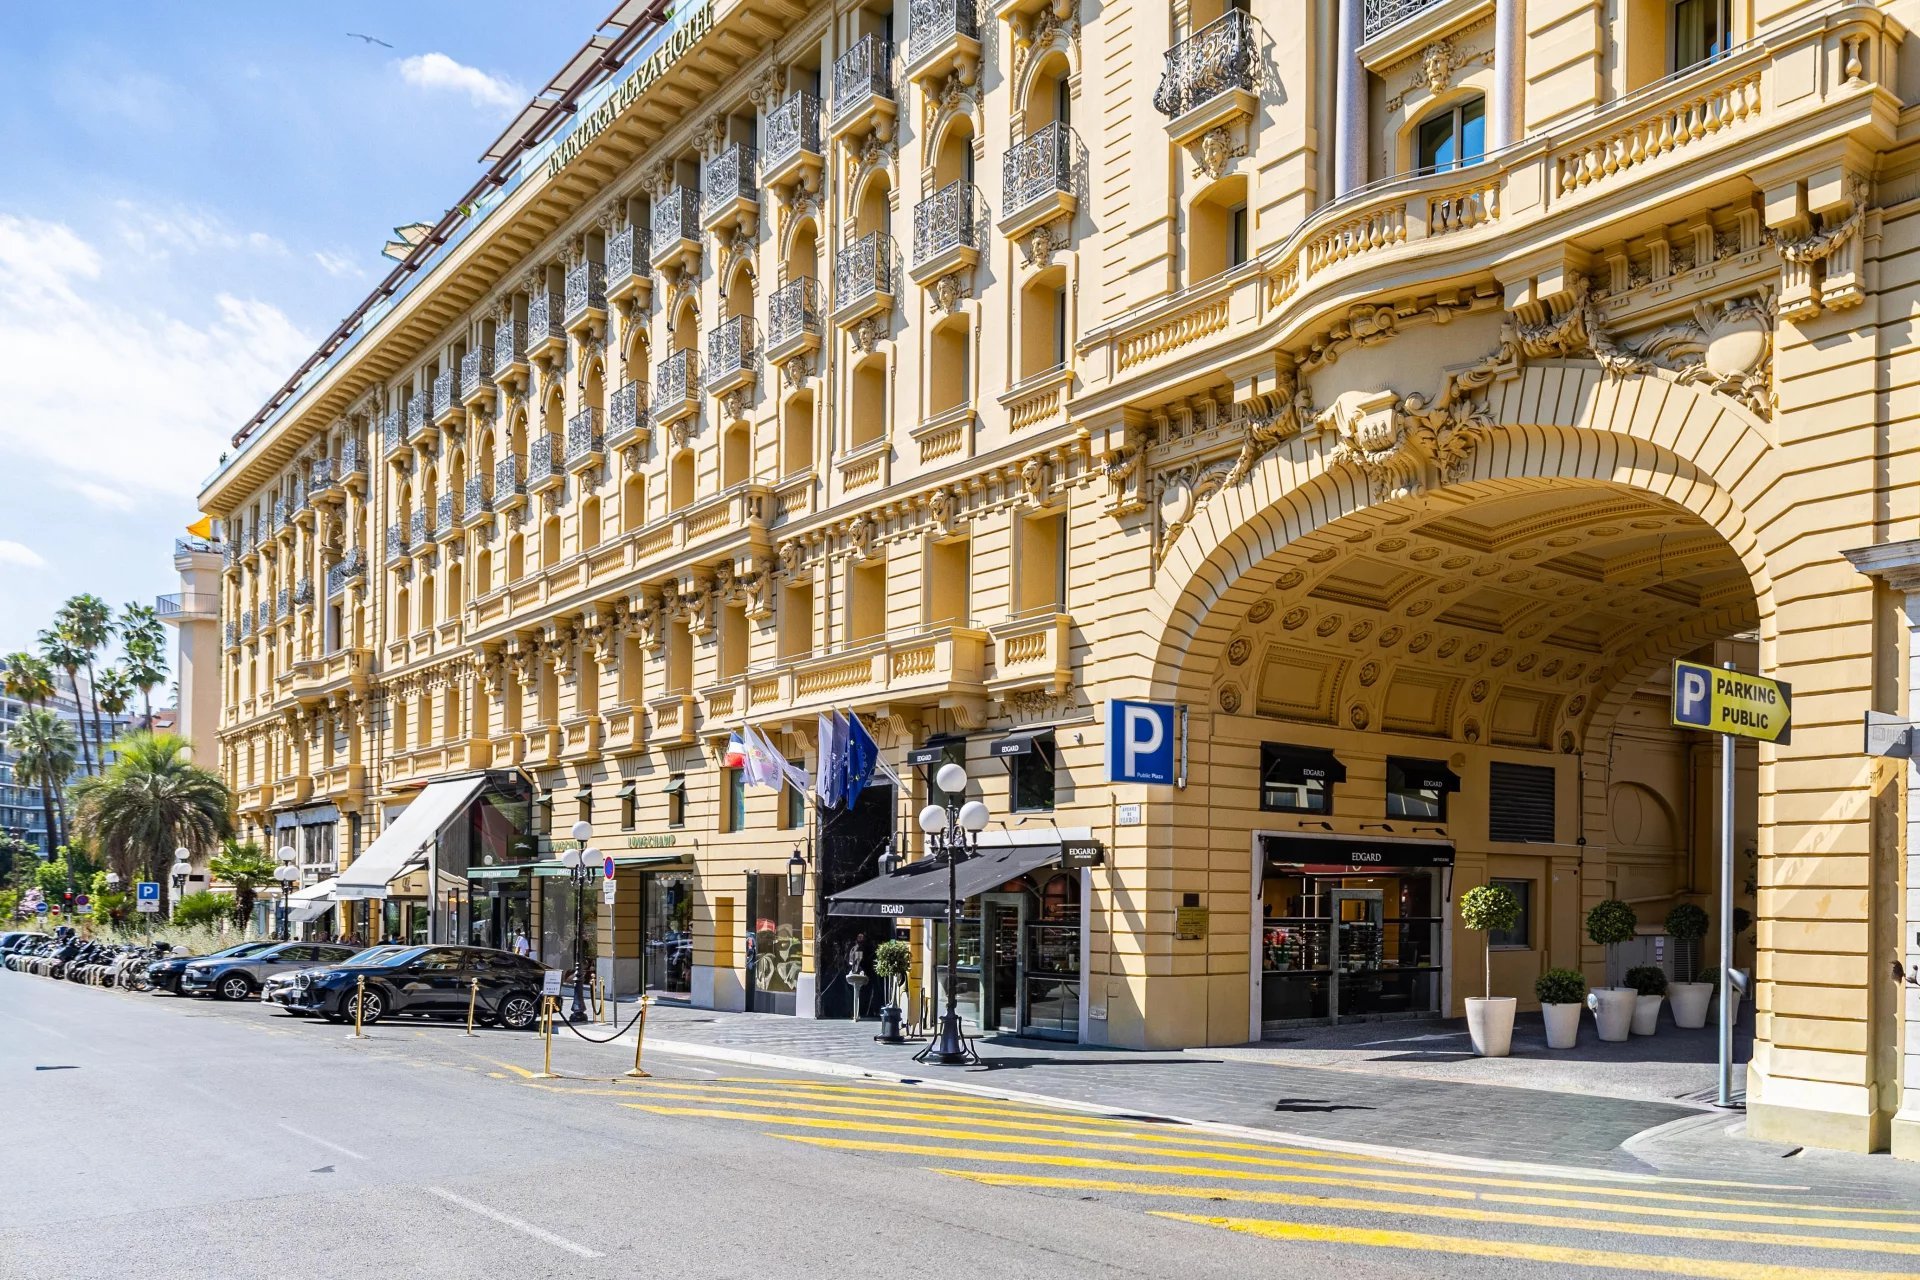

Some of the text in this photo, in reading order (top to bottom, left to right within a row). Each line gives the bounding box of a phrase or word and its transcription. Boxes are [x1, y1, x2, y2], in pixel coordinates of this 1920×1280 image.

[548, 2, 712, 178] ANANTARA PLAZA HOTEL
[1683, 672, 1705, 716] P
[1717, 678, 1776, 705] PARKING
[1722, 706, 1769, 729] PUBLIC
[1124, 705, 1164, 777] P
[1303, 768, 1325, 777] EDGARD
[1423, 780, 1442, 788] EDGARD
[628, 834, 676, 848] LONGCHAMP
[1069, 847, 1097, 855] EDGARD
[1351, 852, 1382, 862] EDGARD
[143, 886, 154, 897] P
[881, 903, 904, 914] EDGARD
